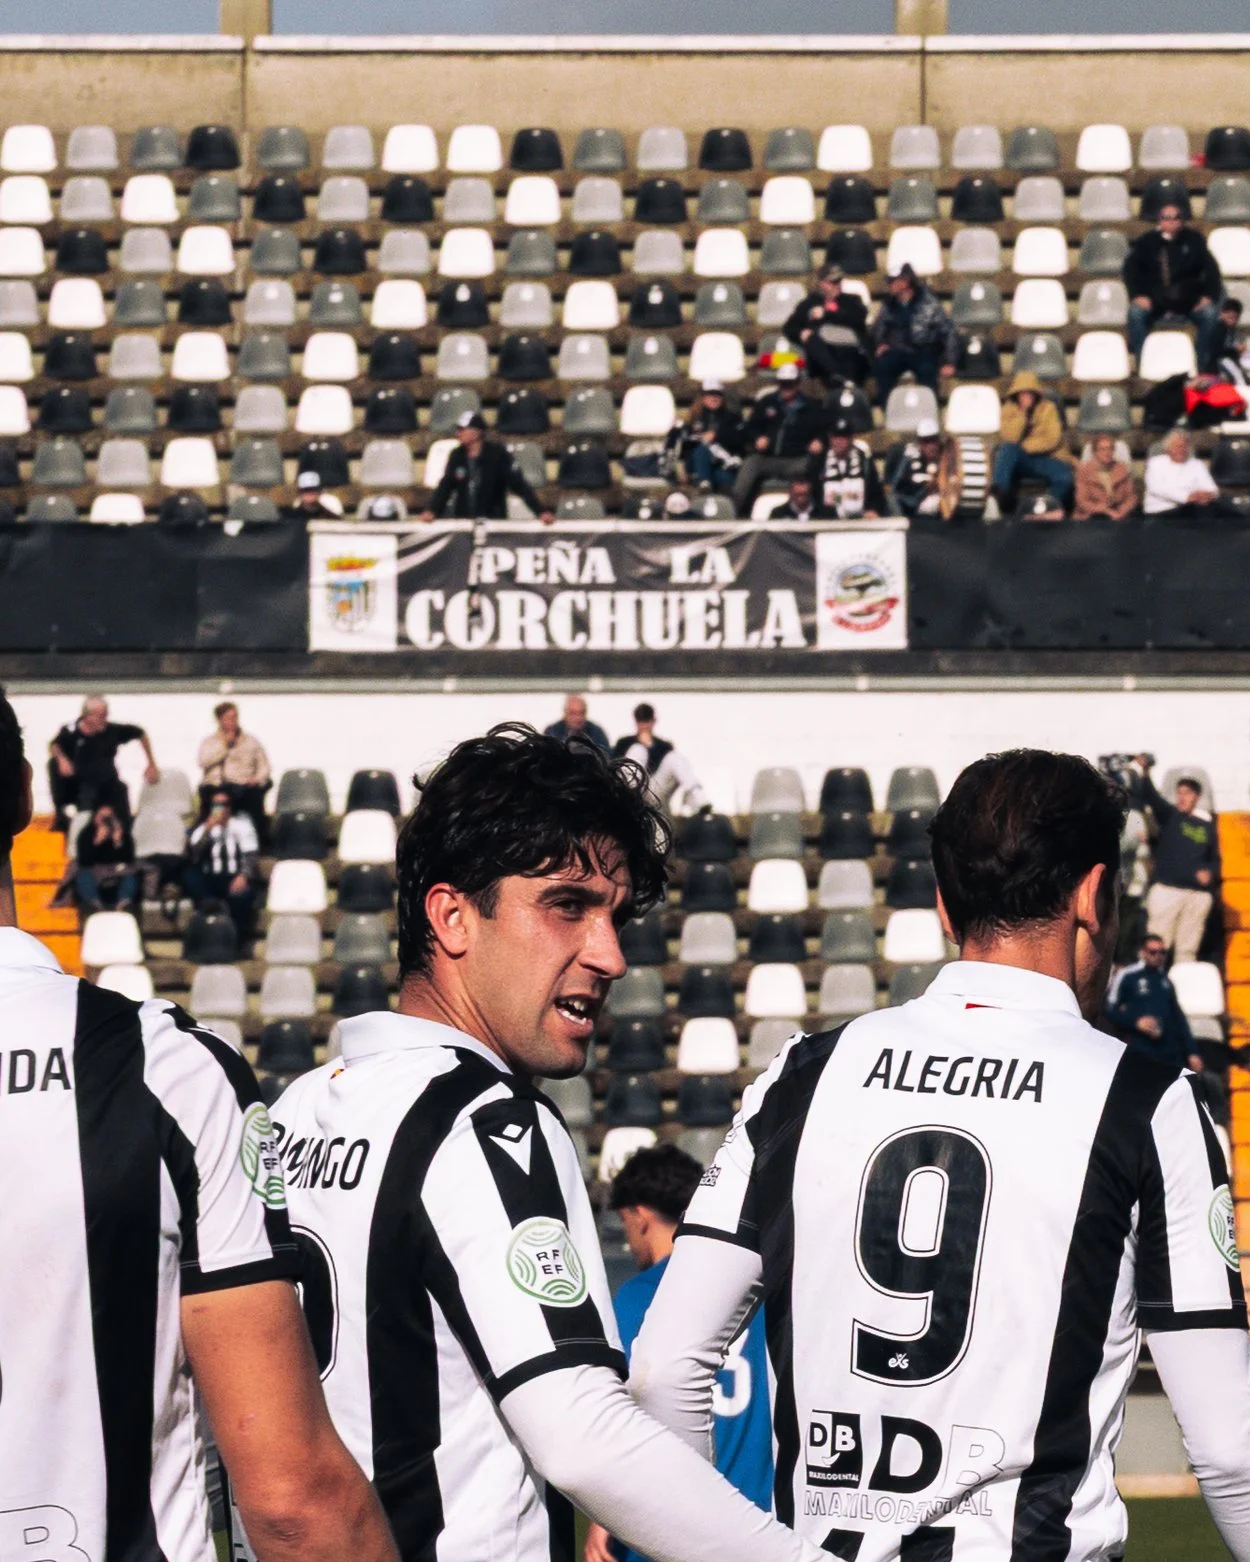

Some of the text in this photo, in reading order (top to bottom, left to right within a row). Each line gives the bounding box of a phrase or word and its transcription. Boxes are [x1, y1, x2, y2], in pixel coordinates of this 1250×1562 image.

[479, 540, 736, 585] PEÑA LA
[404, 589, 806, 650] CORCHUELA
[0, 1047, 72, 1096] DA
[862, 1048, 1045, 1103] ALEGRIA
[536, 1249, 560, 1262] RF
[542, 1264, 564, 1275] EF
[850, 1124, 993, 1387] 9
